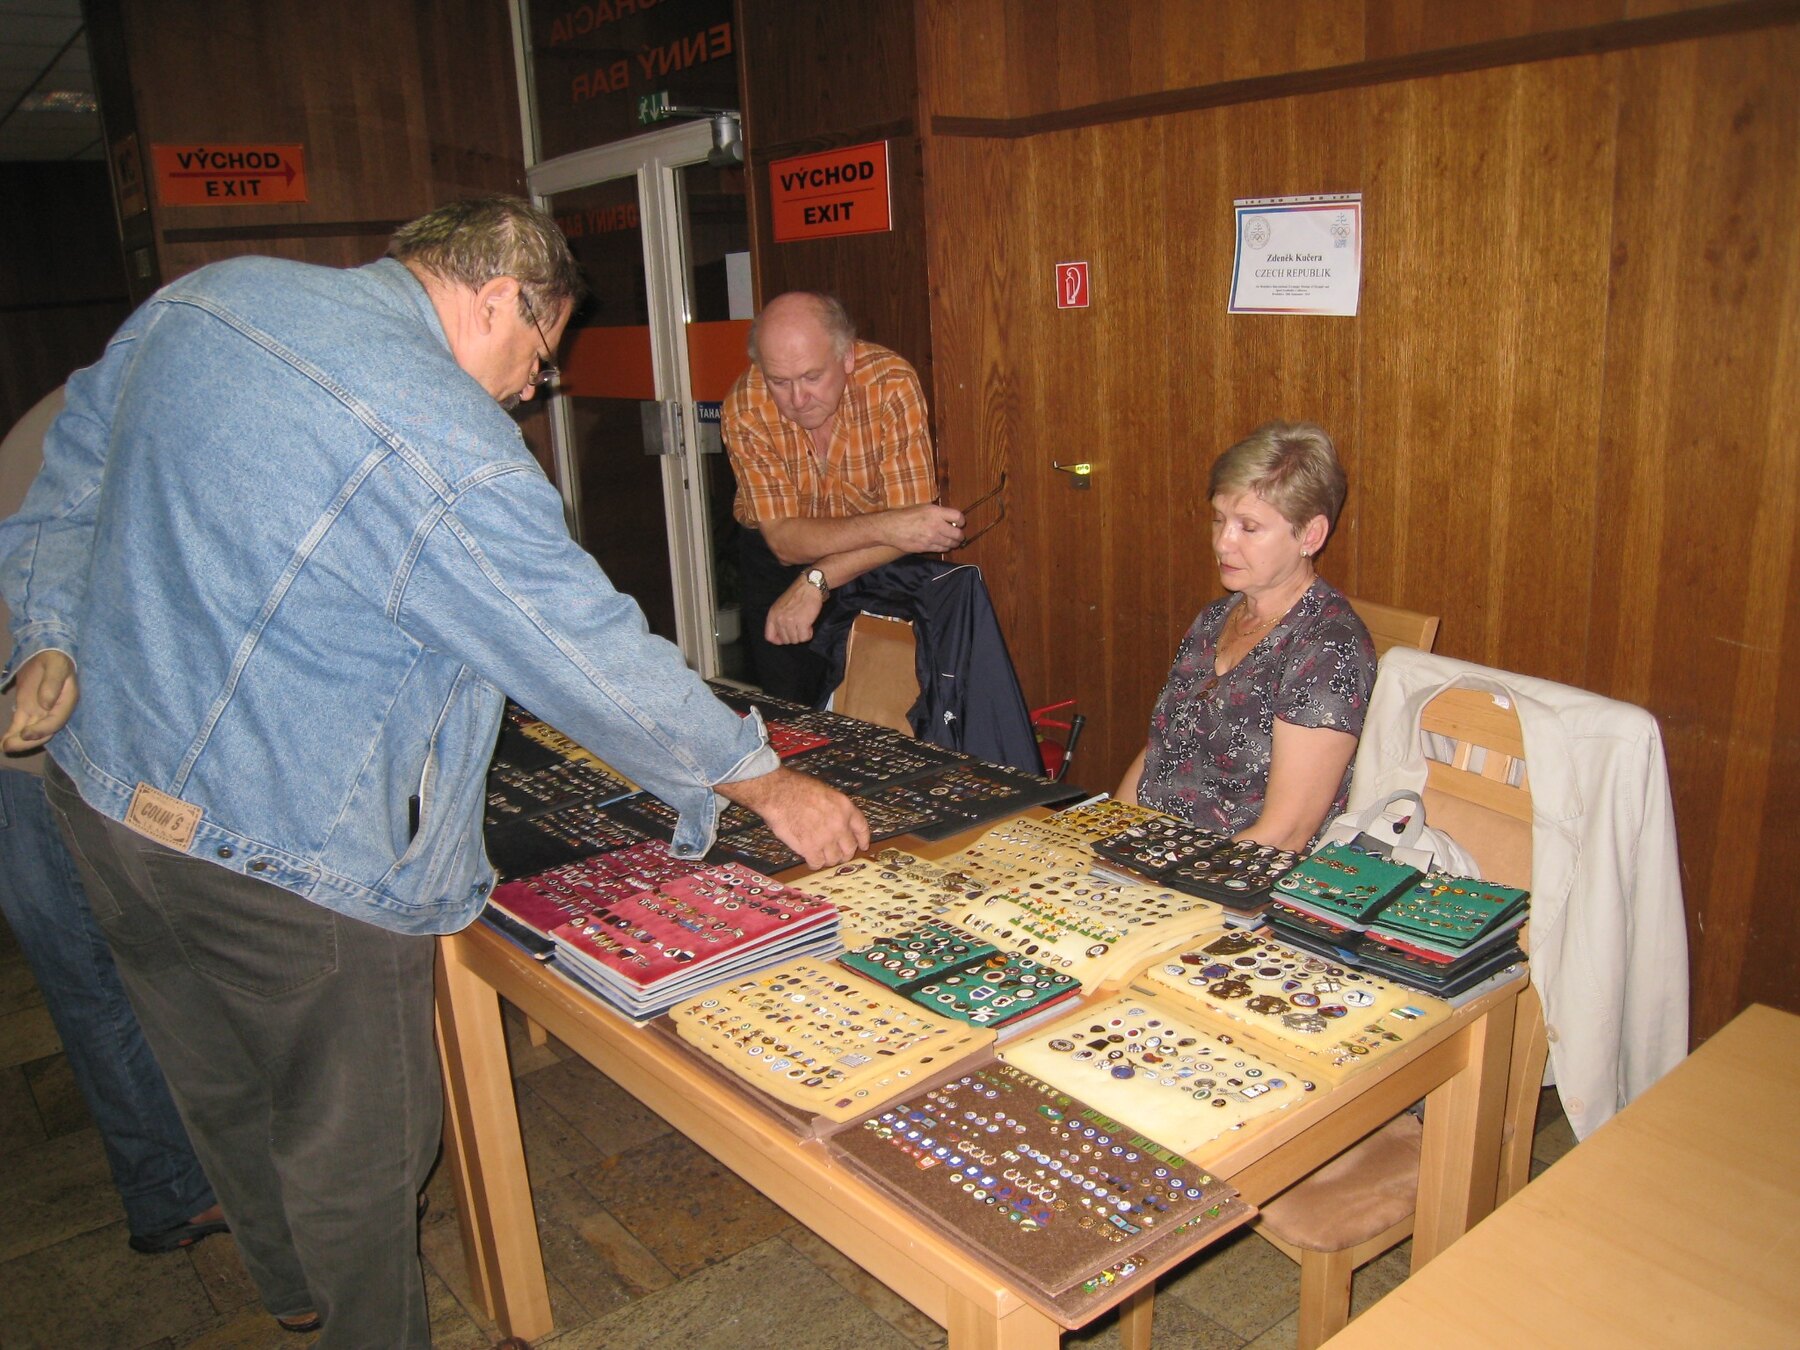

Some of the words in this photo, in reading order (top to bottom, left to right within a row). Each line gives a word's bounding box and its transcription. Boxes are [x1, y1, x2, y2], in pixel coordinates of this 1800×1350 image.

[177, 148, 281, 170] VÝCHOD
[780, 160, 875, 192] VÝCHOD
[206, 180, 261, 197] EXIT
[803, 201, 855, 226] EXIT
[1266, 253, 1294, 262] Zdeněk
[1295, 253, 1323, 262] Kučera
[1254, 268, 1285, 278] CZECH
[1286, 268, 1332, 278] REPUBLIK
[699, 405, 721, 418] ŤAHA
